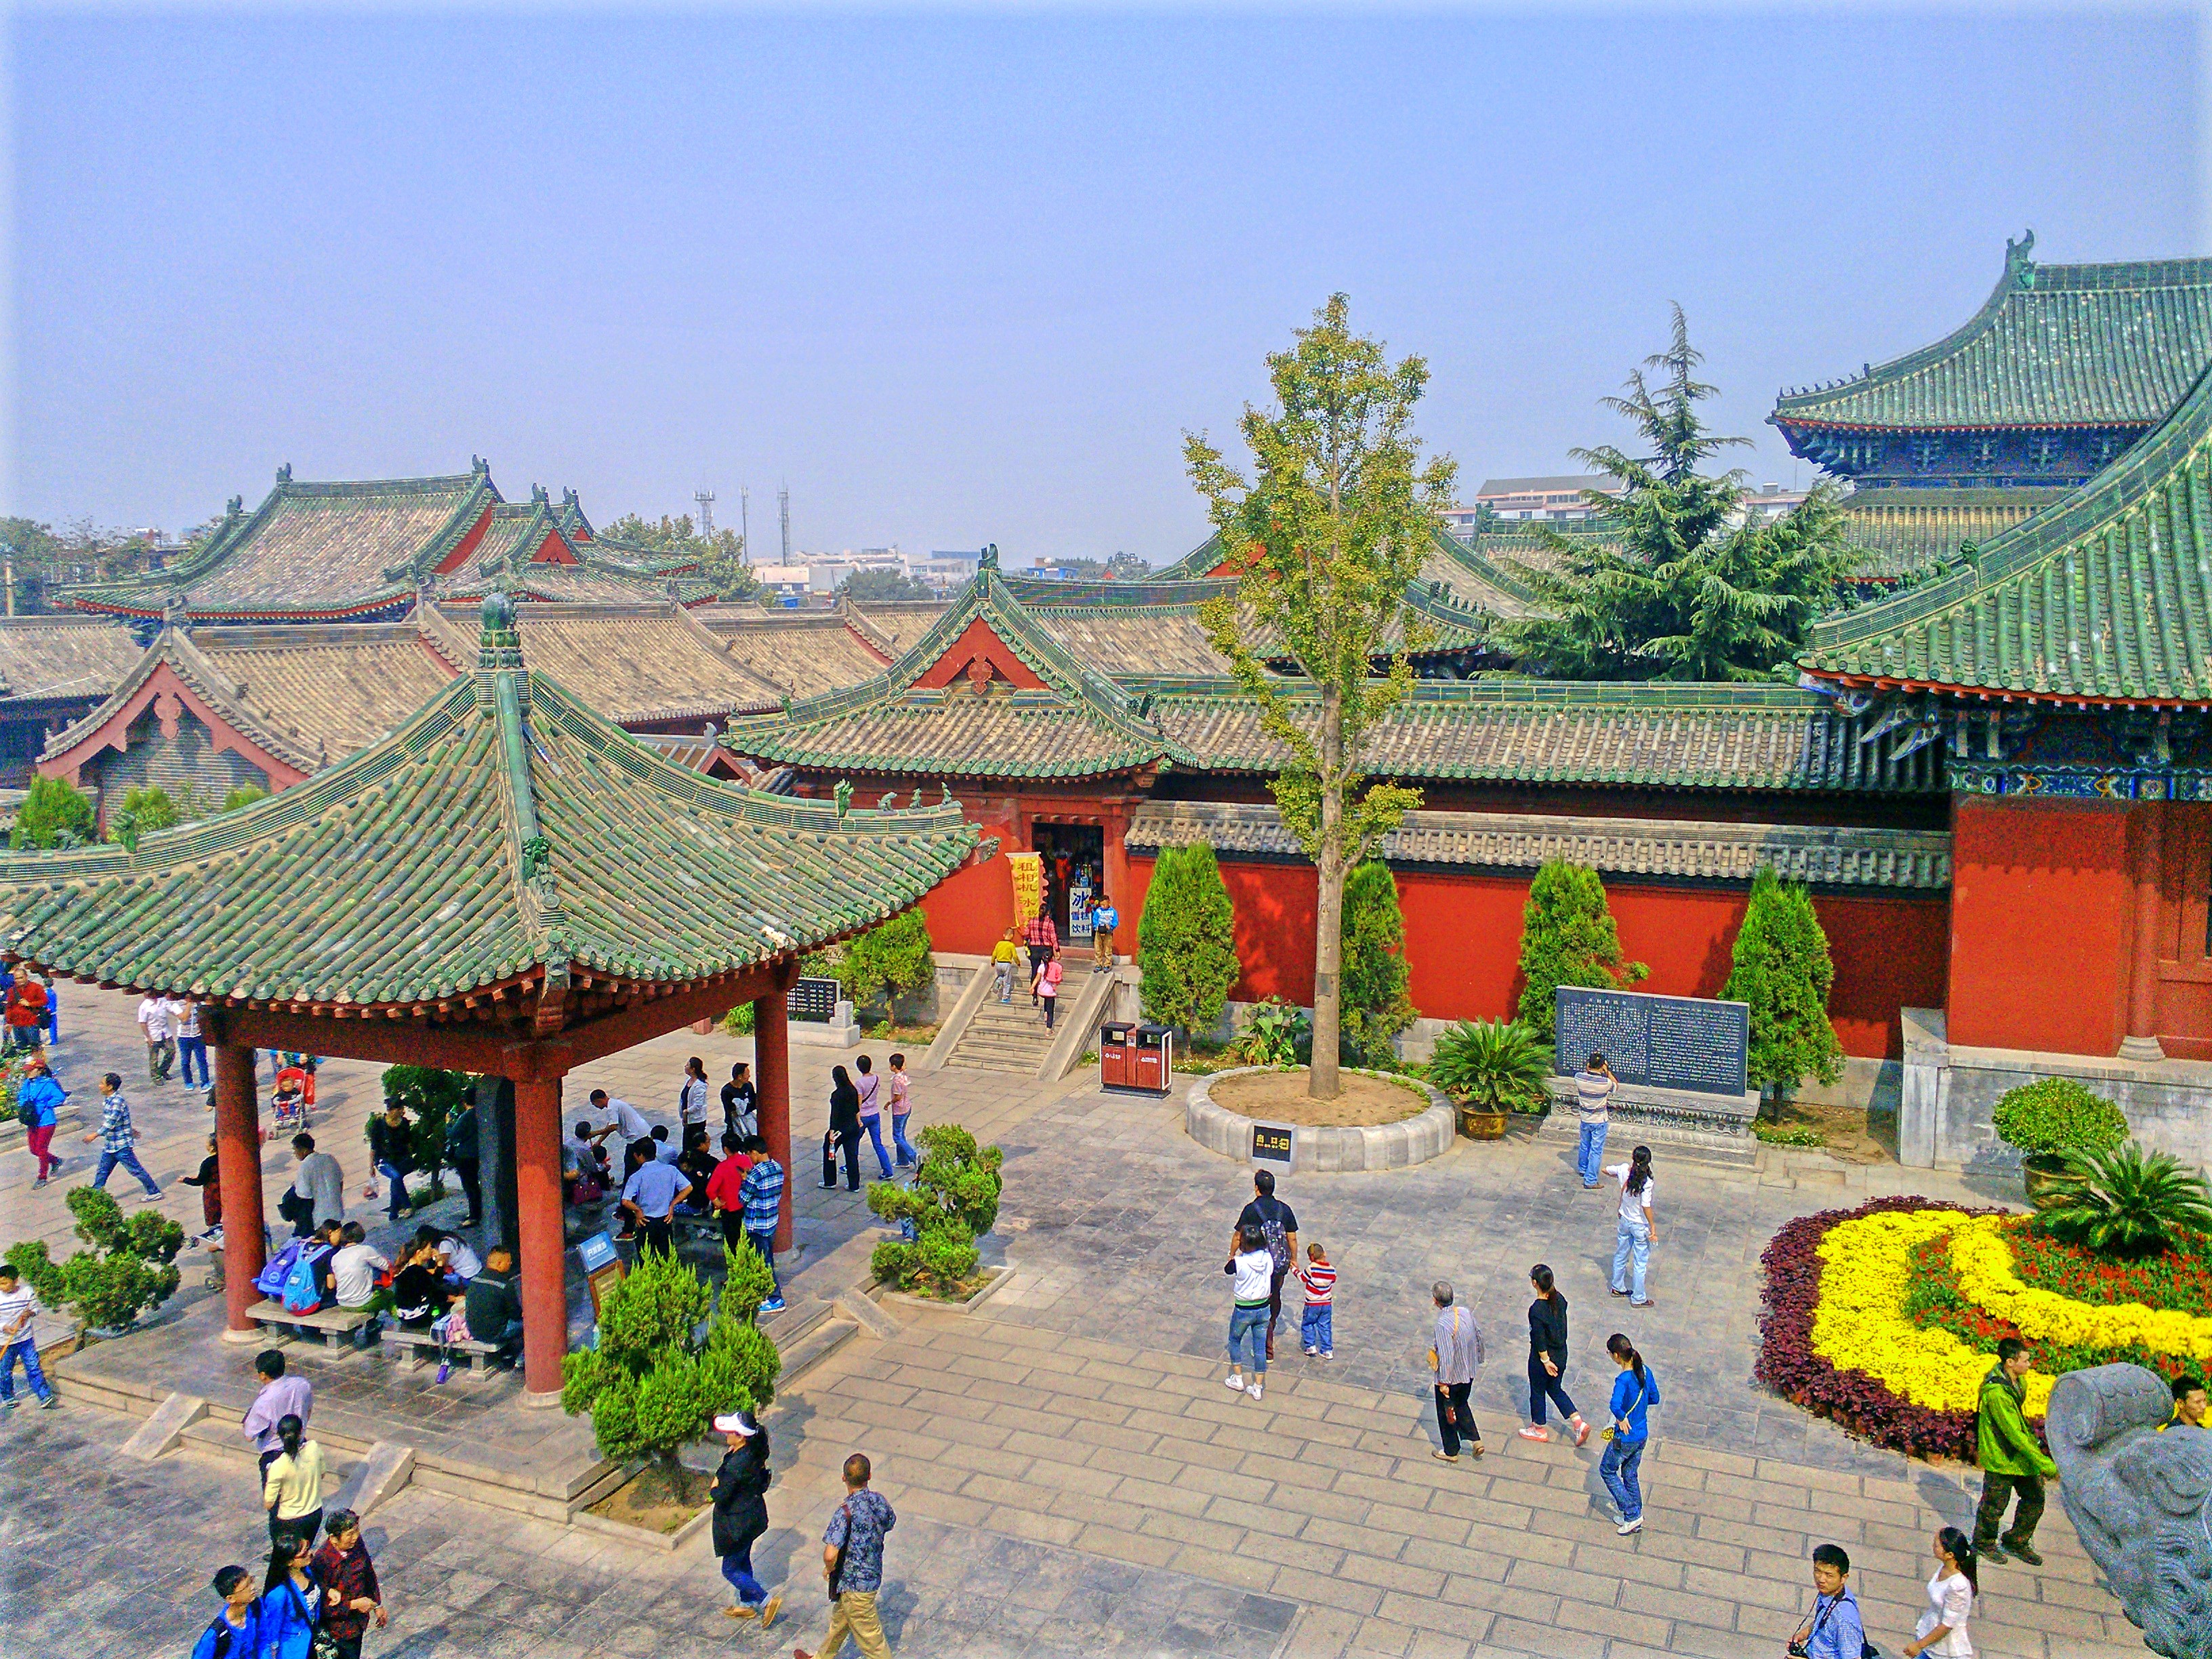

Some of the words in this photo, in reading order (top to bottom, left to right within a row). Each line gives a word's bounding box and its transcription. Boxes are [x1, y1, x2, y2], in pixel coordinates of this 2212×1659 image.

[1016, 862, 1038, 892] 租相机
[1071, 890, 1089, 909] 冰
[1071, 924, 1090, 934] 饮料
